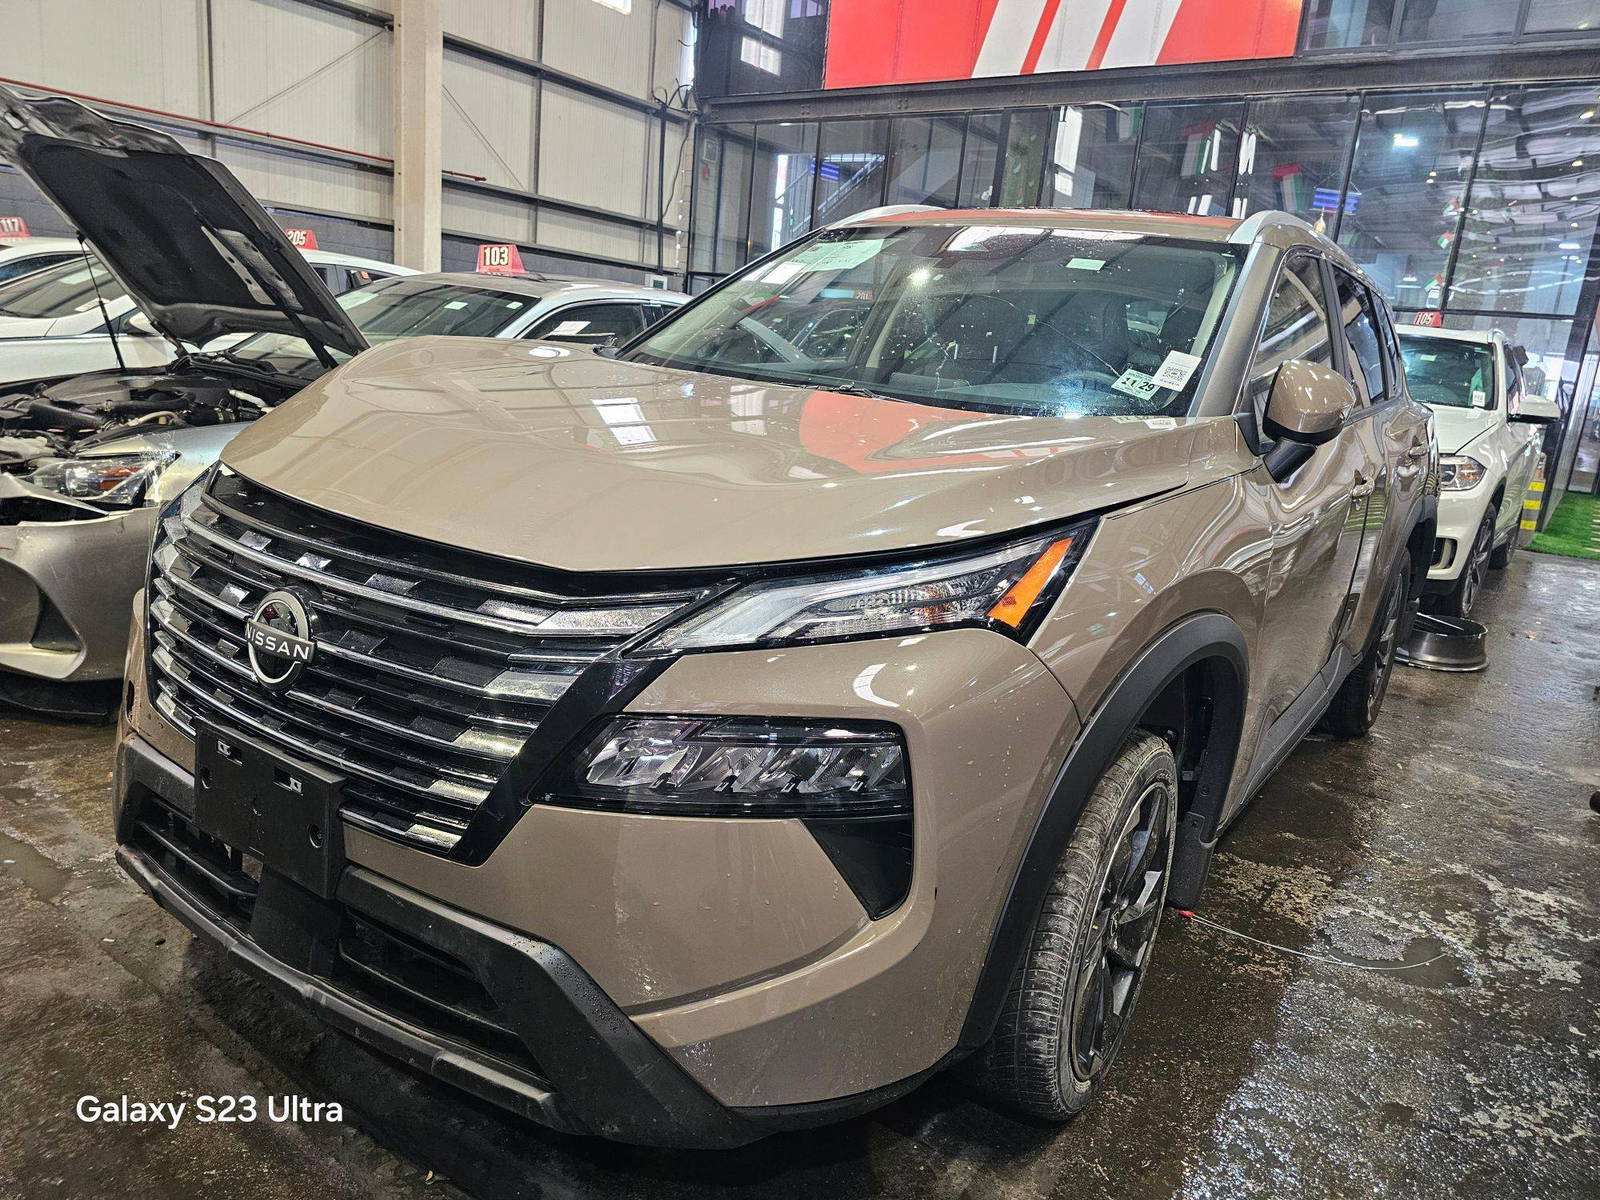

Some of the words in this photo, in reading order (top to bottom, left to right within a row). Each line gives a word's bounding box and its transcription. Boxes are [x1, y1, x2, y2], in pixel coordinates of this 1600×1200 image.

[287, 230, 307, 246] 205
[484, 246, 509, 266] 103
[1138, 381, 1155, 392] 29
[245, 622, 310, 660] NISSAN
